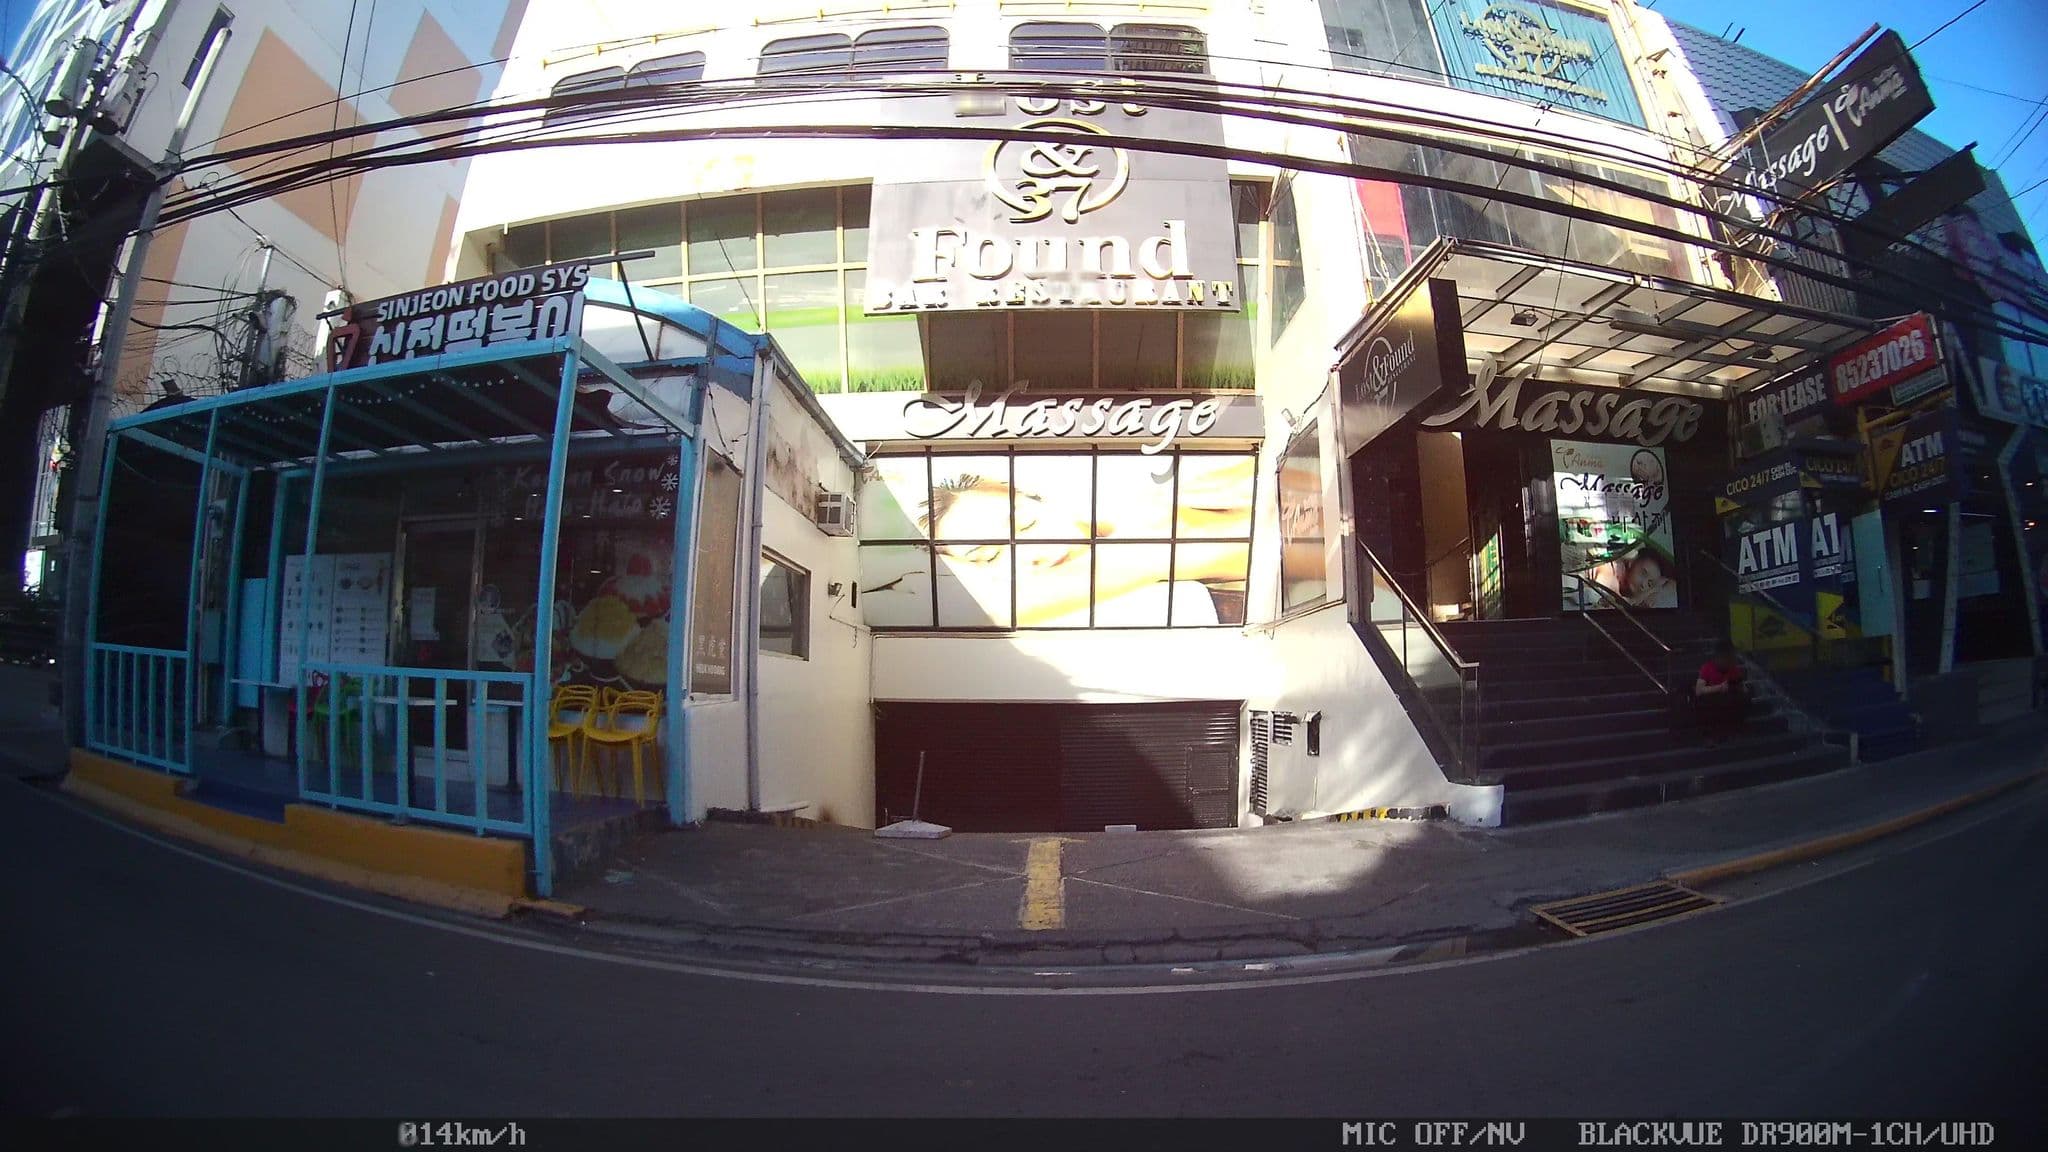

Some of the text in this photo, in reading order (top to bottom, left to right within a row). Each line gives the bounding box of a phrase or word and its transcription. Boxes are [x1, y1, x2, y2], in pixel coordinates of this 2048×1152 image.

[1009, 178, 1092, 224] 37
[910, 218, 1195, 281] Found
[376, 264, 590, 324] SINJEON FOOD SYS
[1384, 328, 1416, 374] Found
[1835, 329, 1926, 394] 85237026
[903, 380, 1223, 455] Massage
[1420, 353, 1704, 447] Massage
[1750, 373, 1828, 424] FOR LEASE
[1901, 431, 1945, 467] ATM
[1726, 477, 1750, 496] CICO
[1738, 522, 1799, 575] ATM
